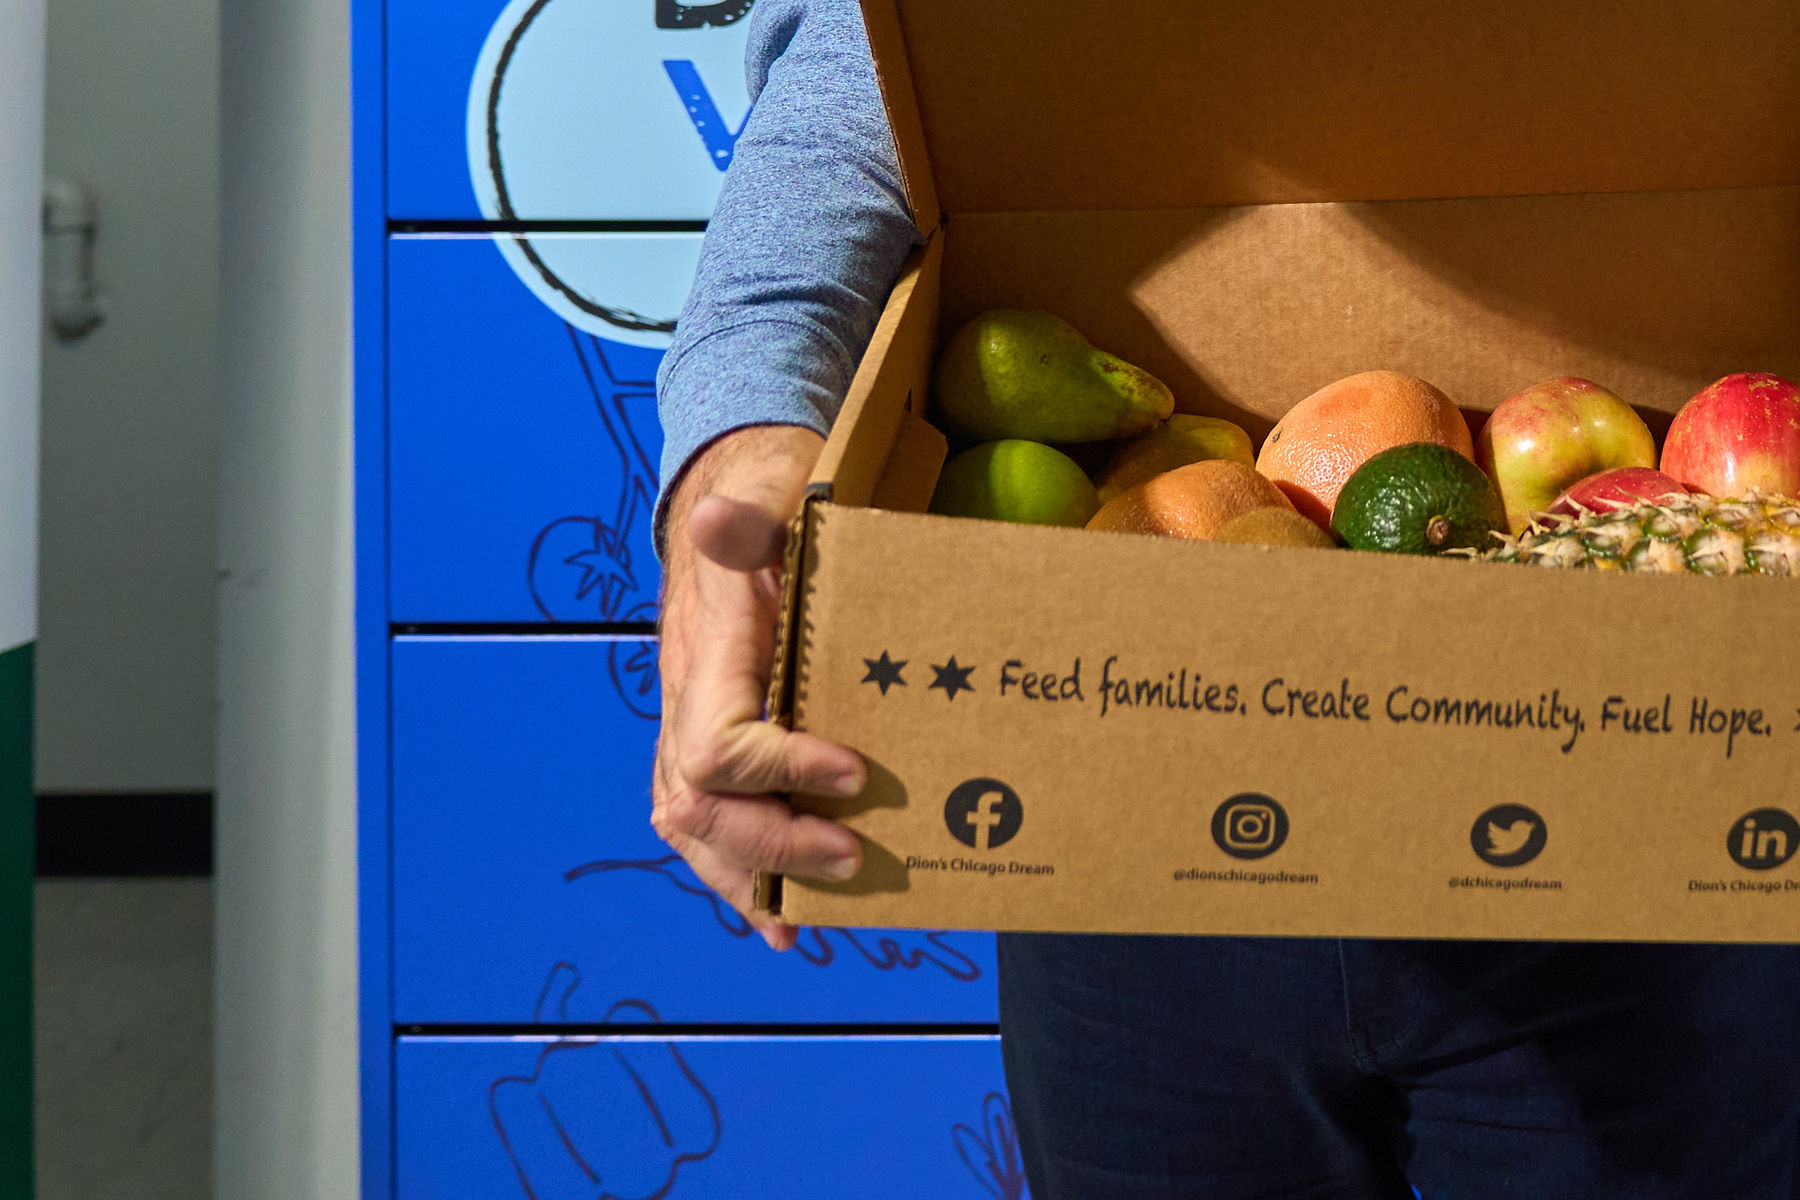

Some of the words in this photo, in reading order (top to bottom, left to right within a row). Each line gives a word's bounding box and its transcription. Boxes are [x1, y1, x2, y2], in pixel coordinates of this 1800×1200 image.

[999, 656, 1085, 702] Feed
[1098, 655, 1247, 718] families.
[1261, 677, 1371, 722] Create
[1385, 685, 1587, 755] Community.
[1600, 693, 1673, 735] Fuel
[1689, 696, 1772, 759] Hope.
[905, 855, 948, 873] Dion's
[949, 857, 1006, 878] Chicago
[1008, 860, 1055, 876] Dream
[1173, 867, 1319, 885] @dionschicagodream
[1448, 876, 1562, 892] @dchicagodream
[1688, 878, 1728, 894] Dion's
[1729, 879, 1783, 895] Chicago
